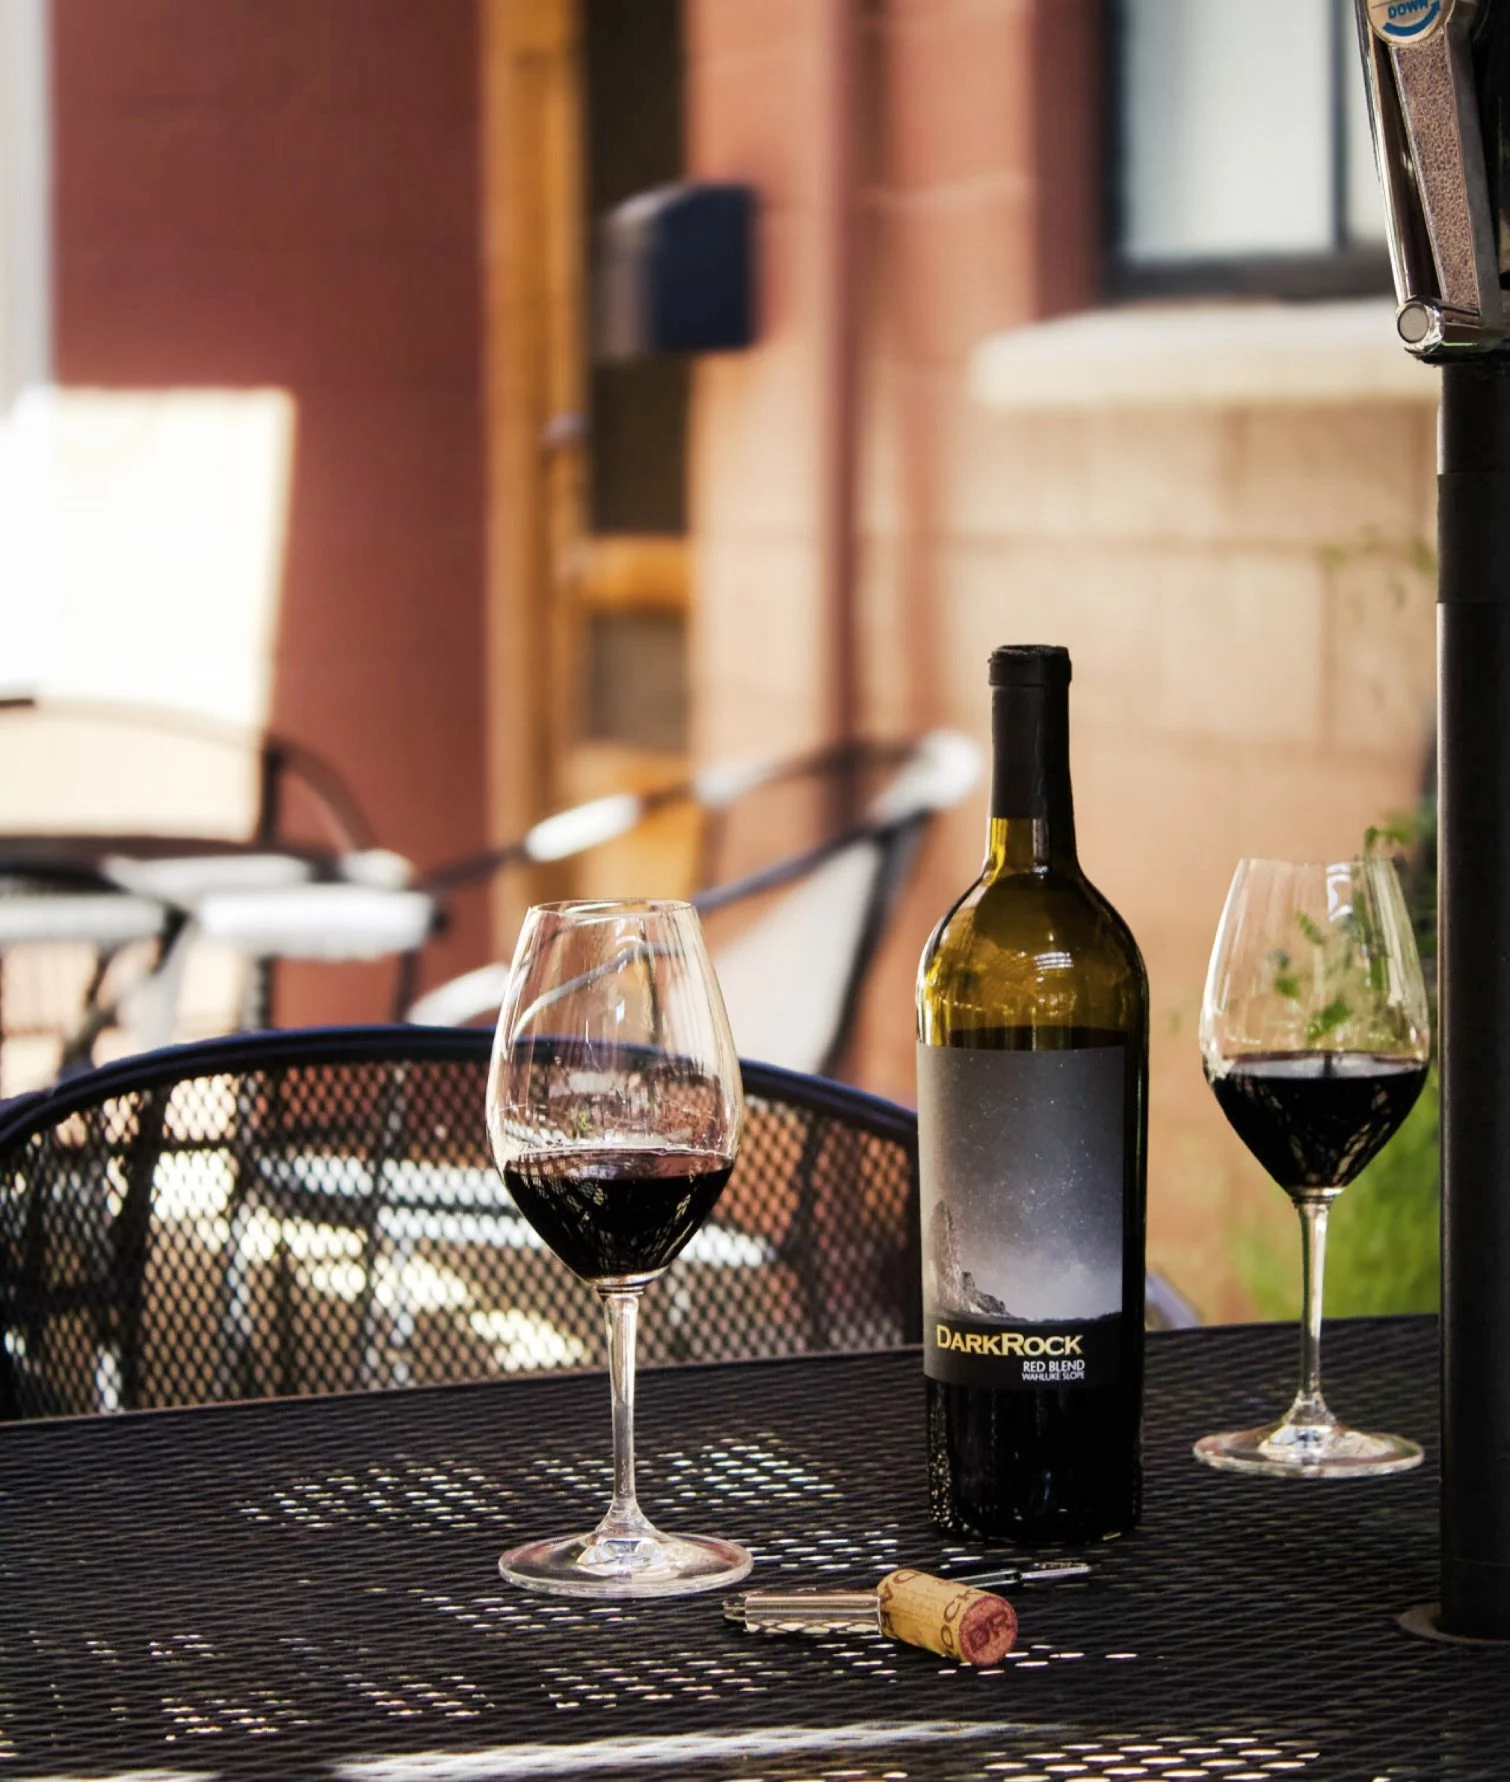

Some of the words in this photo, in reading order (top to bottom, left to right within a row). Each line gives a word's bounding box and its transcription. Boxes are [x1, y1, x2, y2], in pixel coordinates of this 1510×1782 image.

[1388, 0, 1428, 19] DOWN
[1023, 1361, 1046, 1373] RED
[1049, 1359, 1085, 1373] BLEND
[1021, 1372, 1061, 1381] WAHLUKE
[1063, 1371, 1085, 1380] SLOPE
